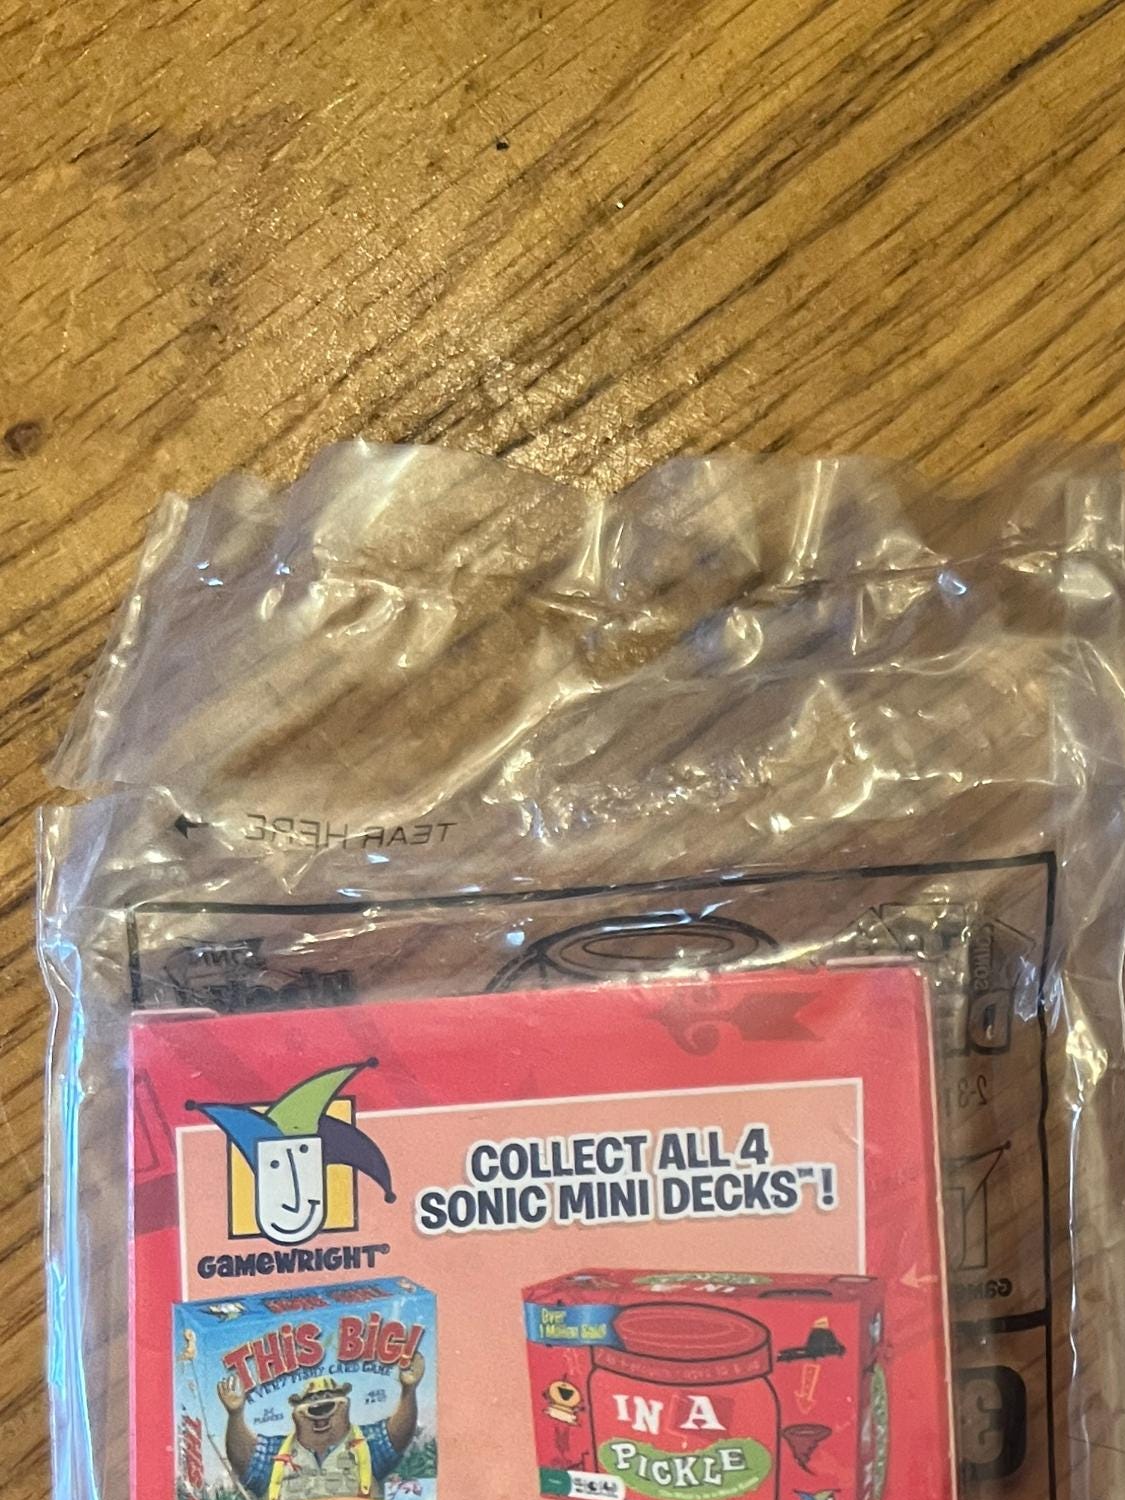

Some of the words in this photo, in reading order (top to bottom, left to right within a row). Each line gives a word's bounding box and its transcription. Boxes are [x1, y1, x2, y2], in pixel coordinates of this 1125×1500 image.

[471, 1135, 647, 1182] COLLECT
[659, 1130, 731, 1171] ALL
[740, 1128, 769, 1166] 4
[420, 1184, 547, 1230] SONIC
[559, 1178, 649, 1221] MINI
[612, 1393, 664, 1435] IN
[680, 1395, 726, 1431] A
[610, 1442, 747, 1488] PICKLE
